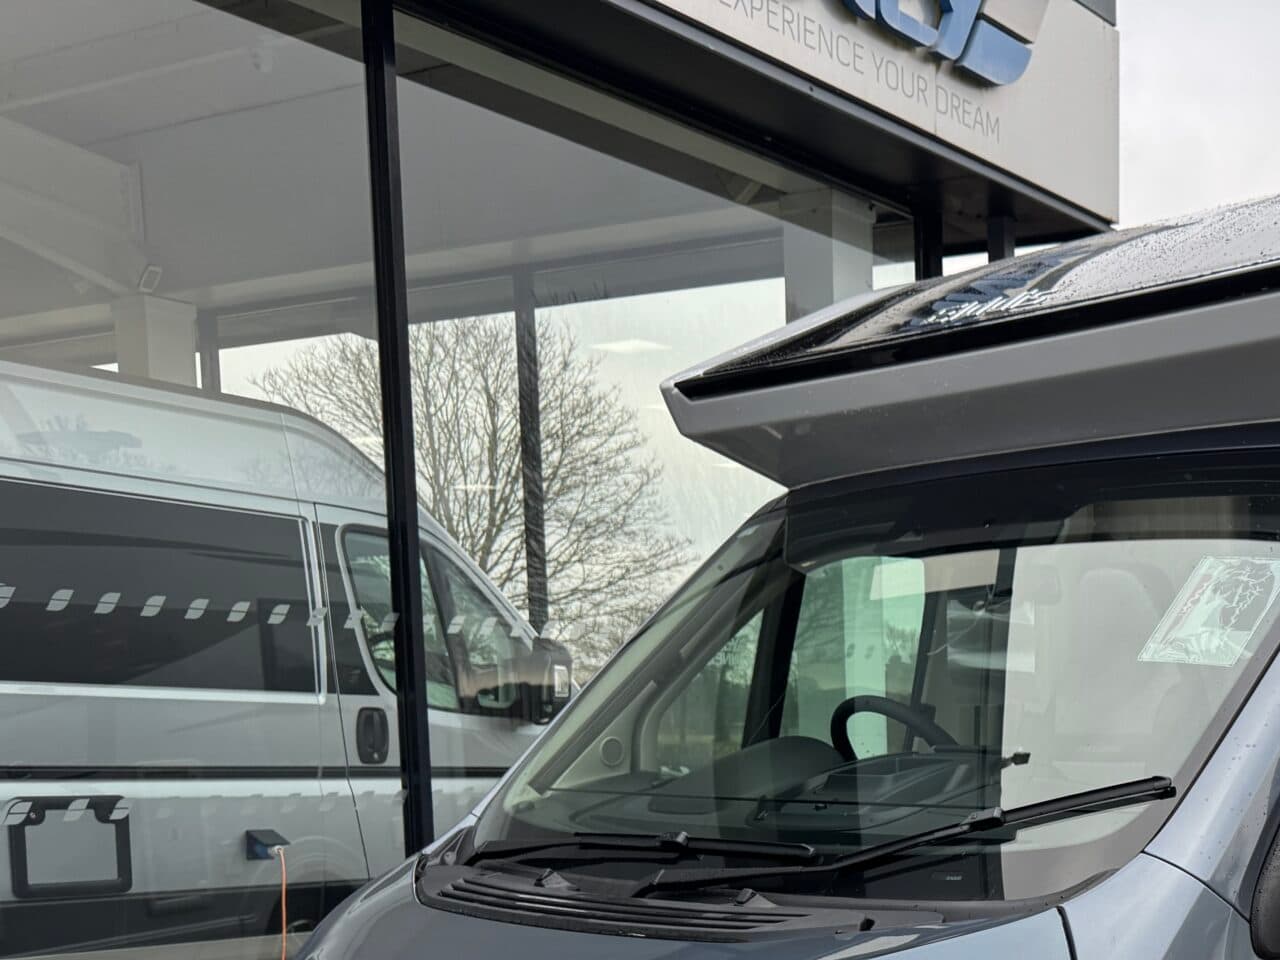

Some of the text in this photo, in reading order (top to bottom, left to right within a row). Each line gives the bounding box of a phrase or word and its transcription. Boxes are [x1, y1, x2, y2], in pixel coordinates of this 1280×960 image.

[719, 0, 865, 75] PERIENCE
[872, 52, 929, 107] YOUR
[936, 85, 1000, 144] DREAM
